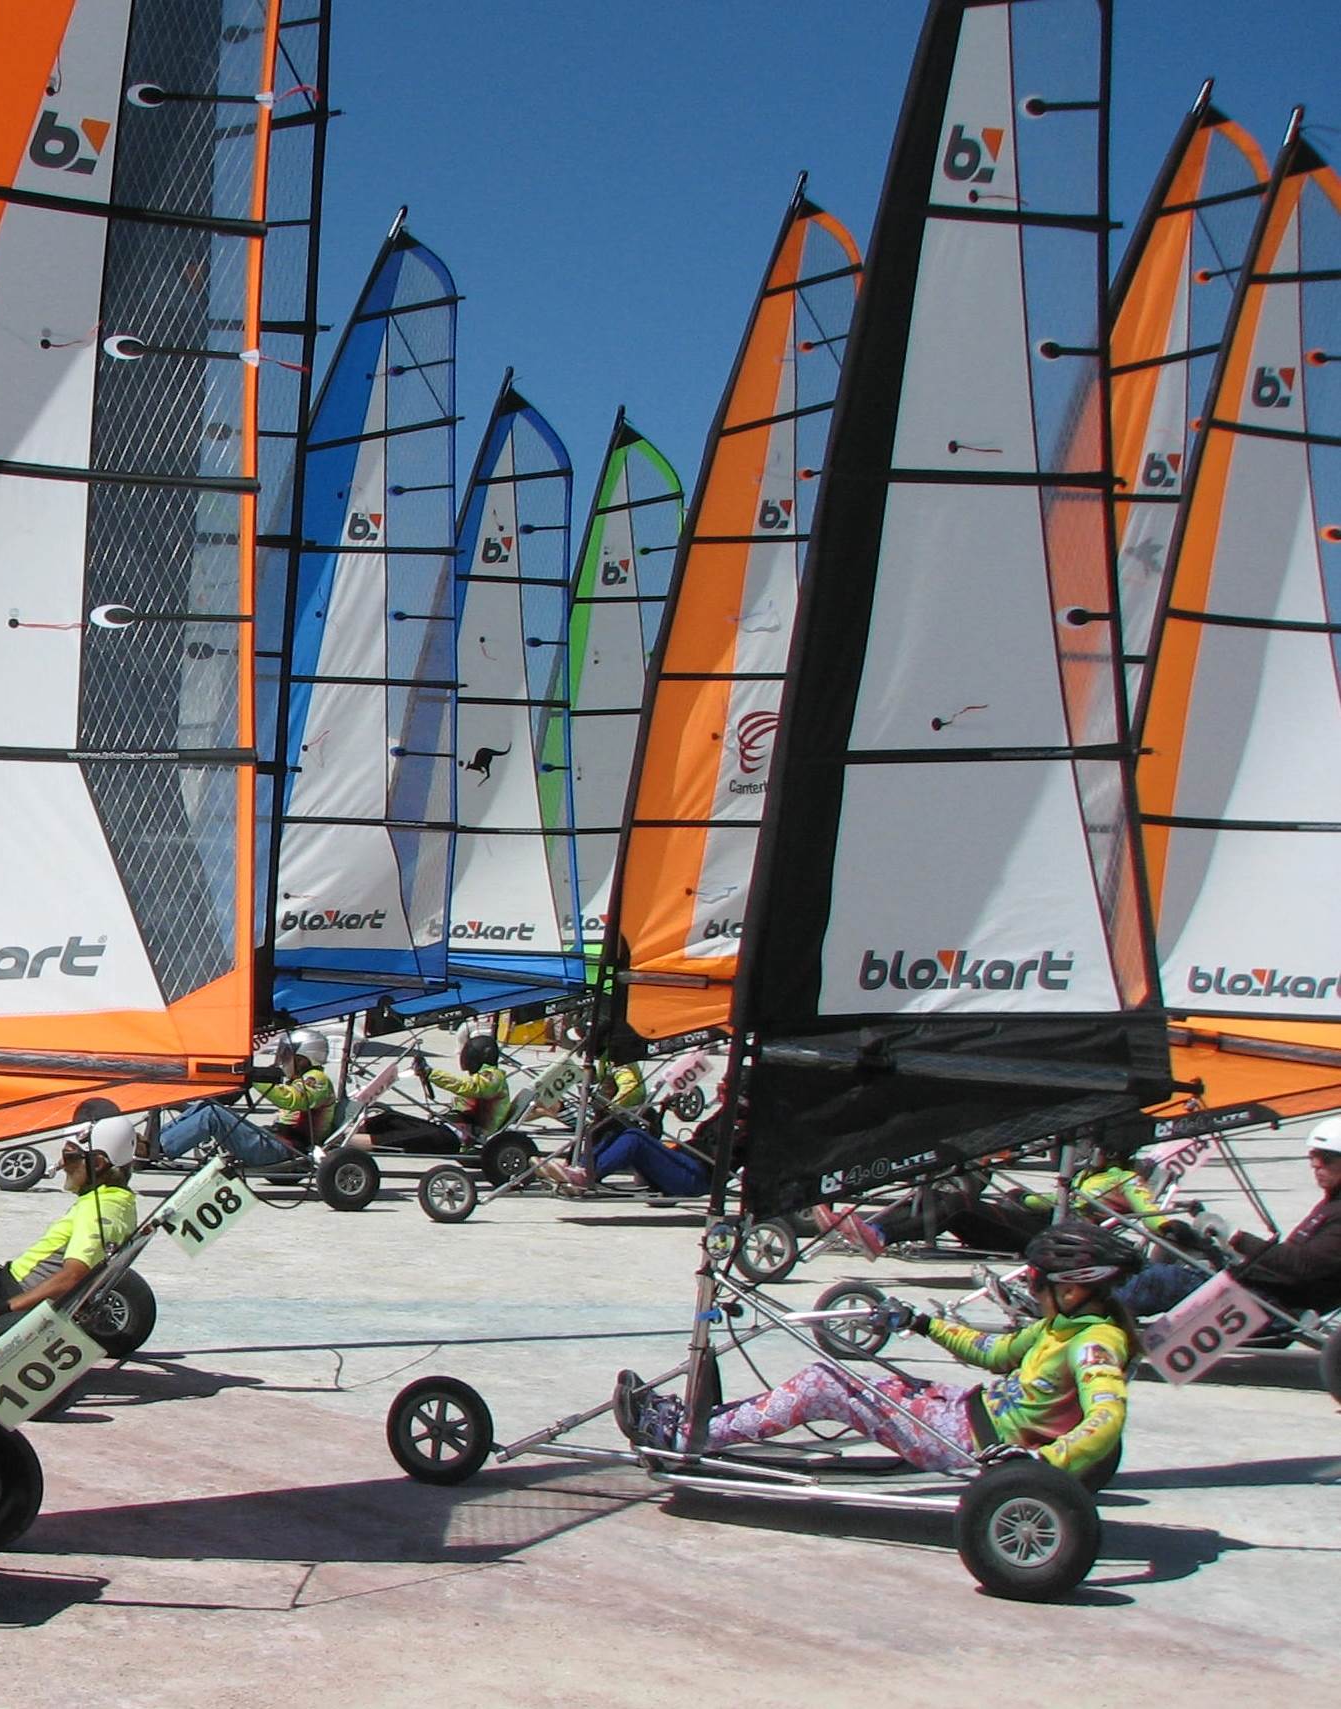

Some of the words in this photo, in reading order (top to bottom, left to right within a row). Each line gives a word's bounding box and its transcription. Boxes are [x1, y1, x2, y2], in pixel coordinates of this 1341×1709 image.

[729, 779, 769, 796] Canter
[281, 909, 387, 931] blokart
[427, 918, 536, 942] bokart
[859, 950, 1075, 990] blokart
[1187, 966, 1341, 999] blokar
[544, 1071, 576, 1100] 103
[673, 1061, 707, 1091] 001
[1213, 1111, 1251, 1124] LITE
[891, 1150, 937, 1171] LITE
[181, 1186, 242, 1243] 108
[1166, 1304, 1248, 1373] 005
